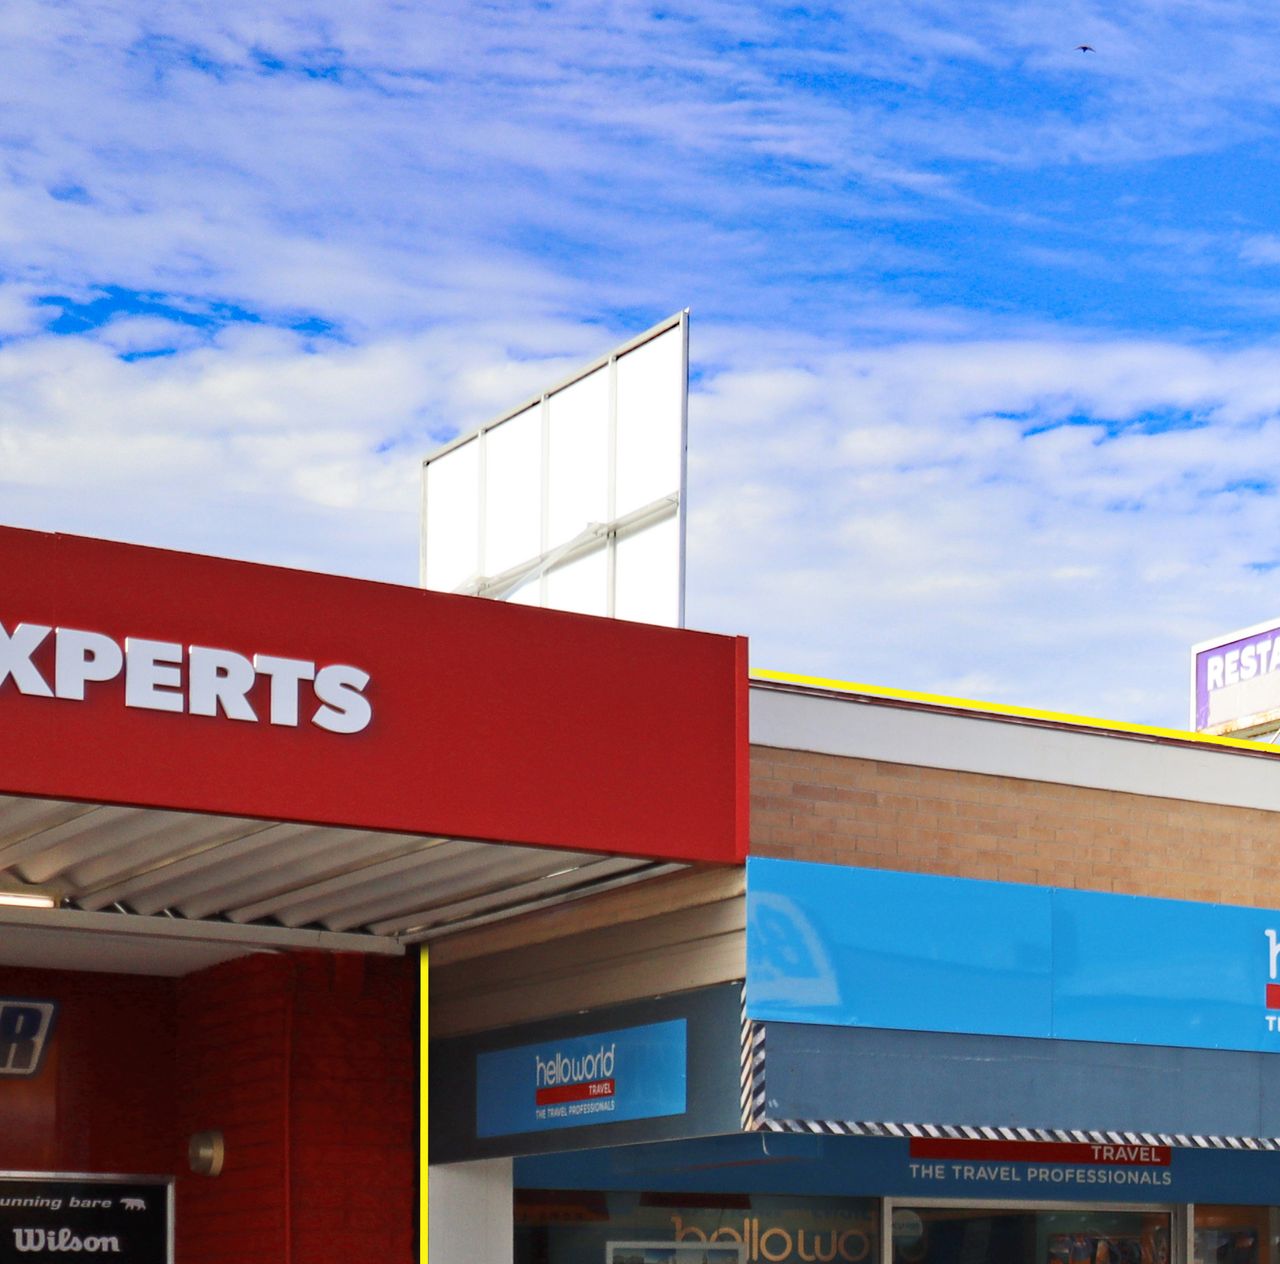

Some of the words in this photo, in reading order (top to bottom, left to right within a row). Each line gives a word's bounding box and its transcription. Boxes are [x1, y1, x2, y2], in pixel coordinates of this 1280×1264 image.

[0, 622, 372, 735] XPERTS
[589, 1083, 612, 1096] TRAVEL
[547, 1106, 567, 1118] TRAVEL
[569, 1100, 615, 1115] PROFESSIONALS
[1091, 1145, 1161, 1161] TRAVEL
[909, 1164, 947, 1180] THE
[952, 1166, 1020, 1182] TRAVEL
[1026, 1168, 1172, 1186] PROFESSIONALS
[0, 1196, 62, 1210] unning
[69, 1196, 112, 1209] bare
[13, 1228, 121, 1252] Wilson
